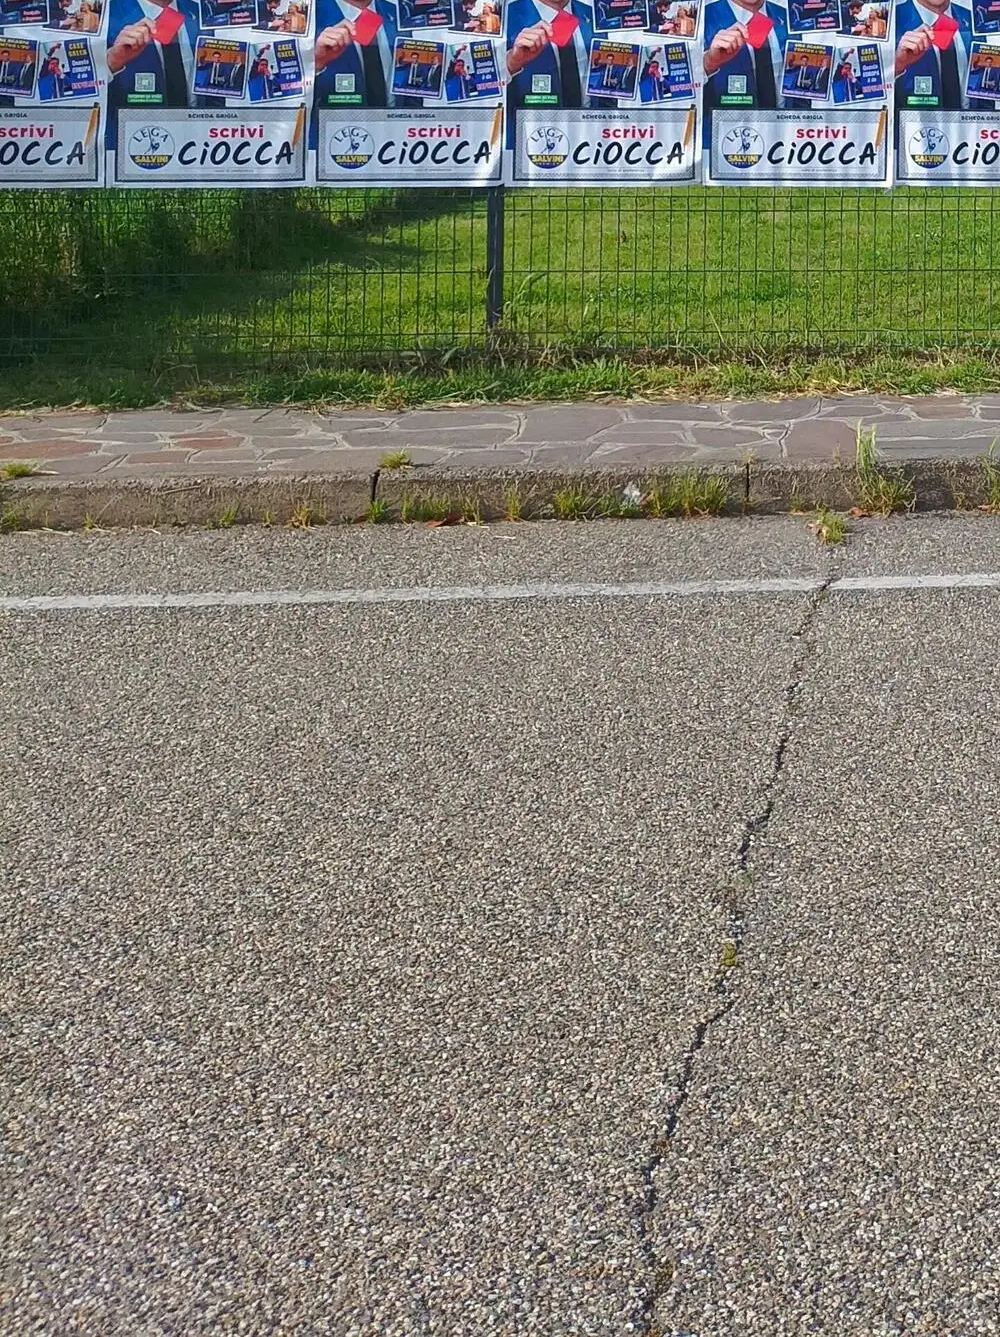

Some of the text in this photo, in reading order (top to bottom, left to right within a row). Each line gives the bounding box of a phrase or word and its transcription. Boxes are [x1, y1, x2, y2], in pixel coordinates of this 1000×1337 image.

[0, 124, 54, 138] scrivi
[133, 128, 169, 142] LEGA
[209, 125, 264, 138] scrivi
[334, 128, 368, 142] LEGA
[408, 125, 461, 138] scrivi
[530, 128, 564, 142] LEGA
[602, 126, 654, 138] scrivi
[726, 128, 759, 142] LEGA
[796, 126, 847, 139] scrivi
[912, 128, 944, 143] LEGA
[0, 140, 86, 166] OCCA
